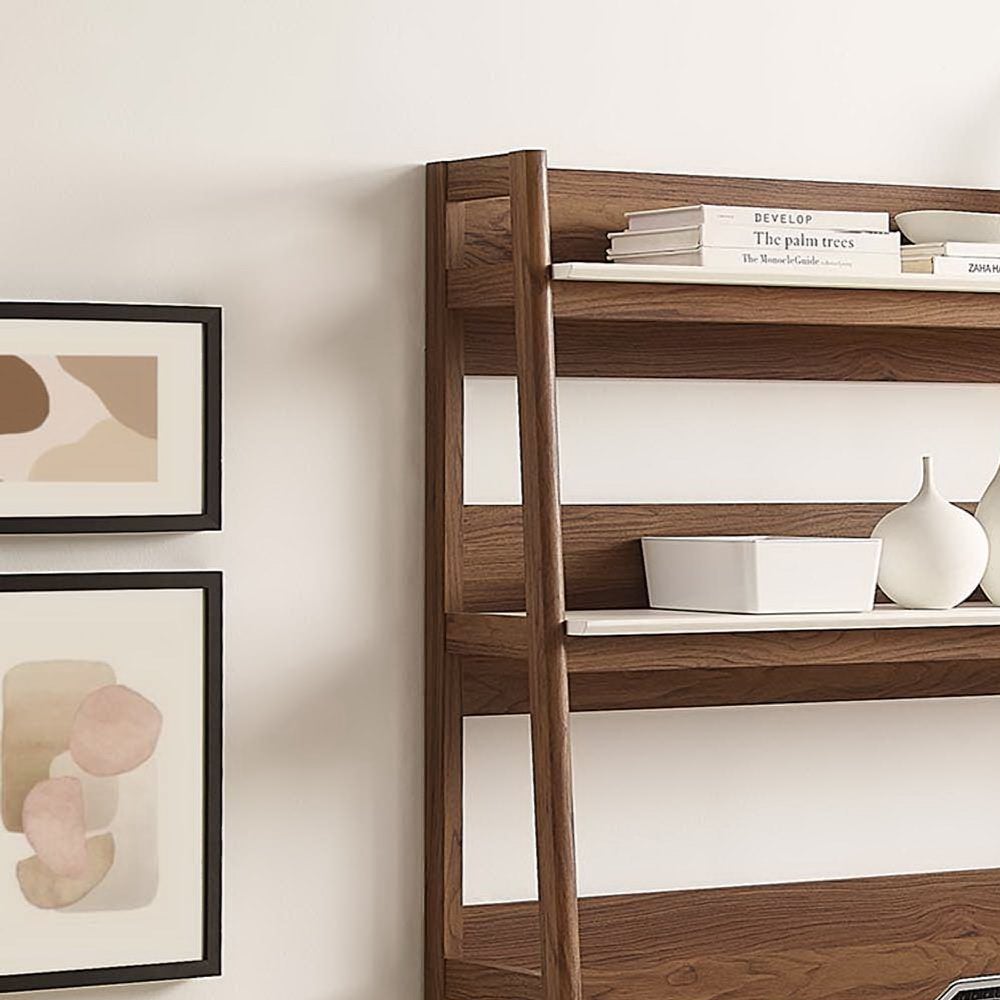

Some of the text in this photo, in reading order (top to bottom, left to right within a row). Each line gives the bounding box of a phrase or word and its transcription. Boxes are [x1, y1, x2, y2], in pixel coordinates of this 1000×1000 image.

[754, 213, 813, 225] DEVELOP
[753, 231, 855, 250] The palm trees
[742, 253, 759, 263] The
[968, 263, 991, 273] ZAHA
